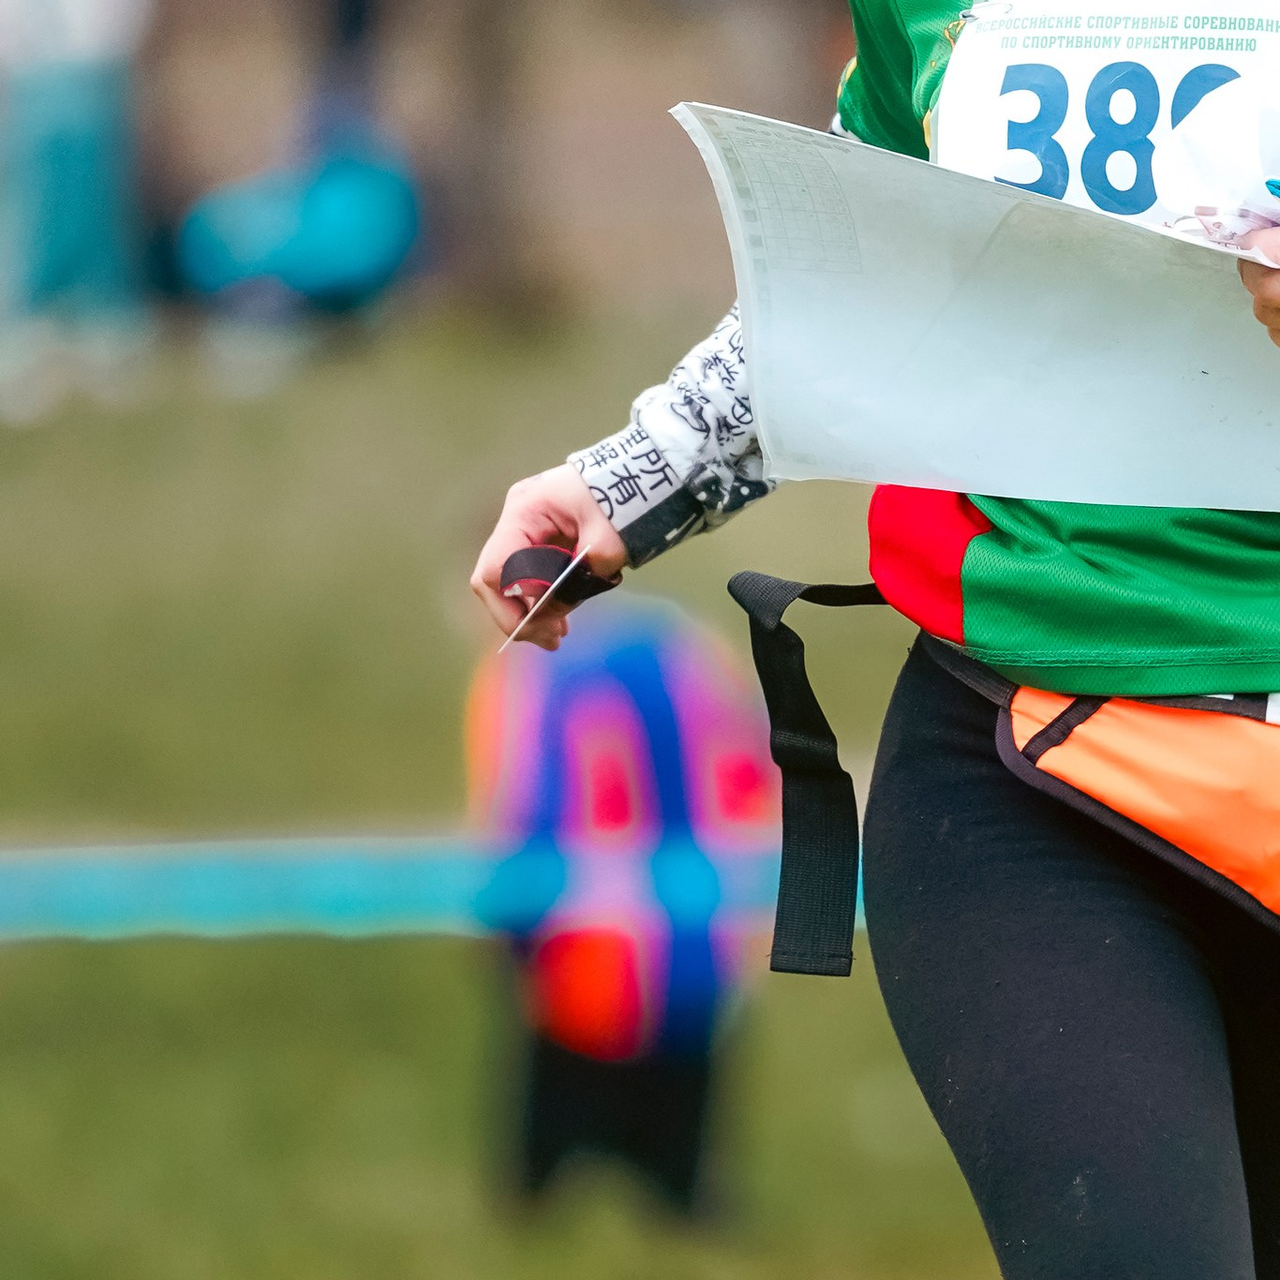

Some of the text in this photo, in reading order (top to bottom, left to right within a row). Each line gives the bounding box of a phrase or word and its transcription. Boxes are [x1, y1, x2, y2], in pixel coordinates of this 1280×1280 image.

[975, 14, 1082, 33] ВСЕРОССИЙСКИЕ
[1087, 15, 1179, 30] СПОРТИВНЫЕ
[1001, 35, 1257, 52] ПО СПОРТИВНОМУ ОРИЕНТИРОВАНИЮ
